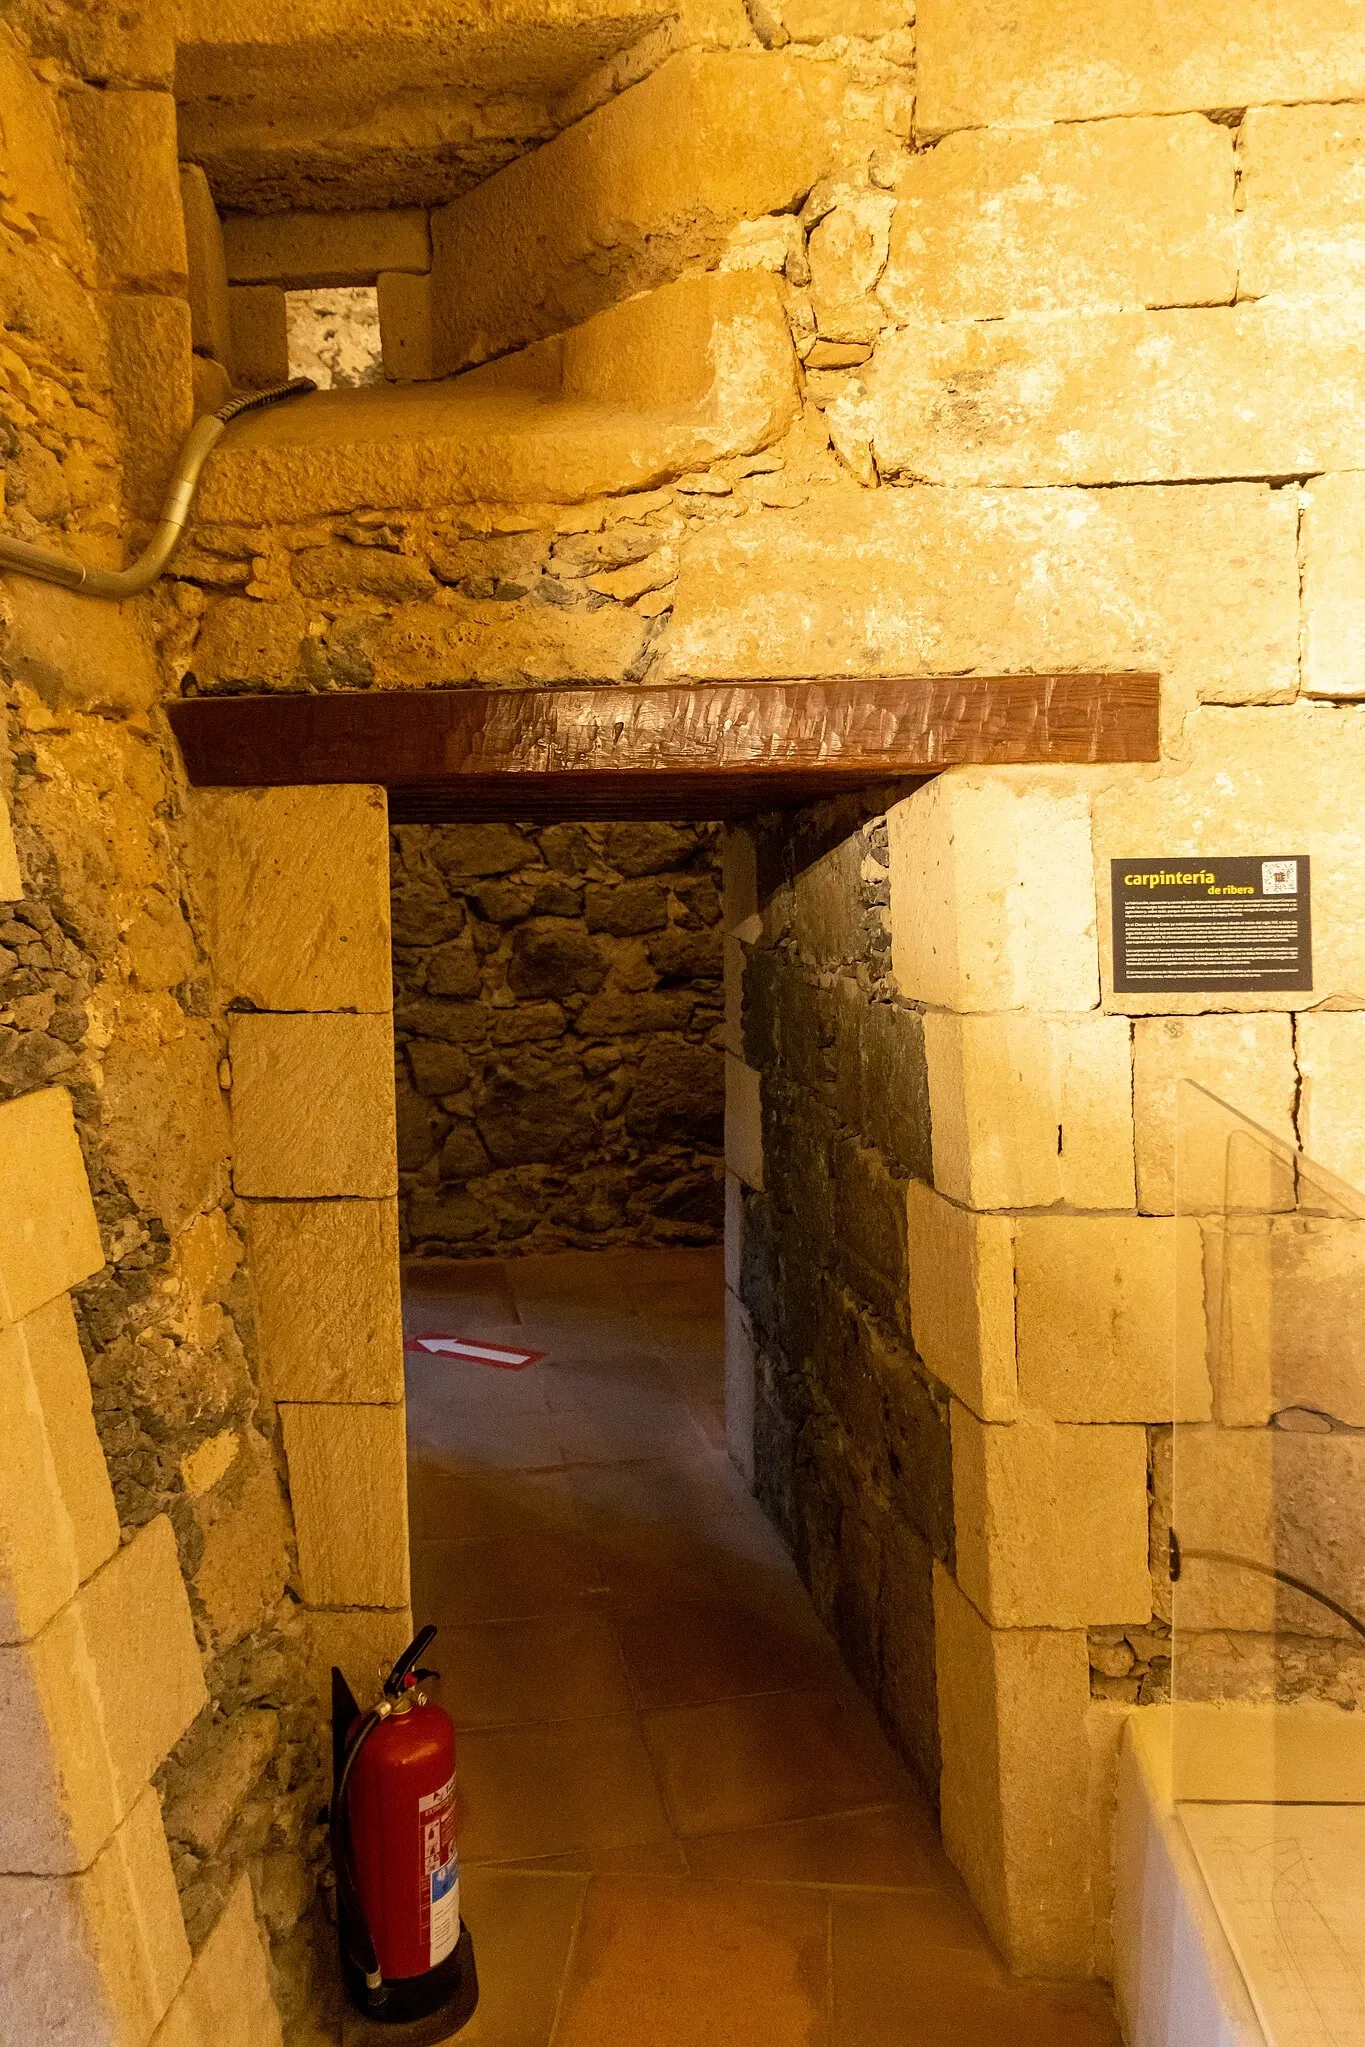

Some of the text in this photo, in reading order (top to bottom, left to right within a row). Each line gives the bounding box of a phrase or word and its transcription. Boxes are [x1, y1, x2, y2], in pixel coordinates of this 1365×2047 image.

[1124, 869, 1215, 889] carpintería
[1207, 885, 1255, 895] de ribera
